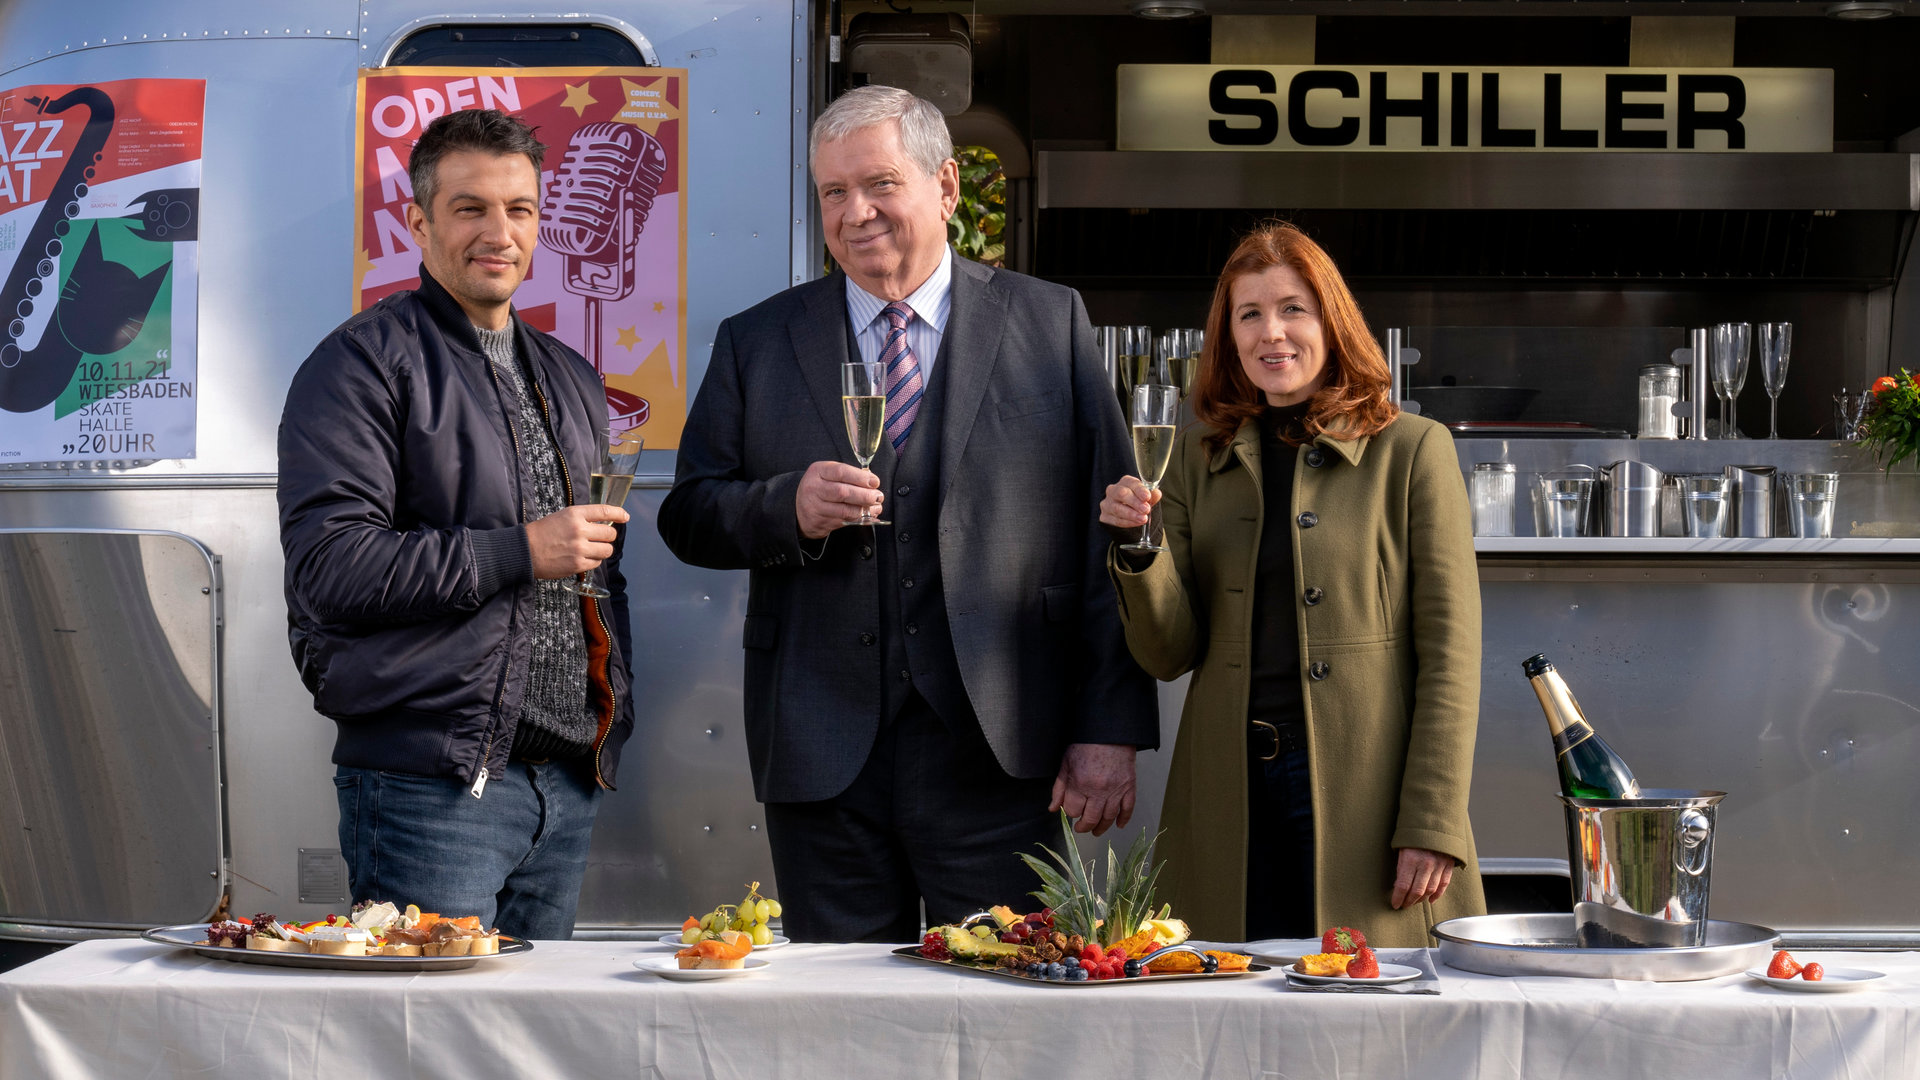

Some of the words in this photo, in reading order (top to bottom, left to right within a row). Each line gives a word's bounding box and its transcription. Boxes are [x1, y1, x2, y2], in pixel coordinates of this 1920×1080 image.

[621, 111, 645, 119] MUSIK
[1208, 69, 1747, 149] SCHILLER
[79, 360, 170, 382] 10.11.21
[79, 382, 192, 400] WIESBADEN
[79, 401, 132, 416] SKATE
[79, 418, 133, 432] HALLE
